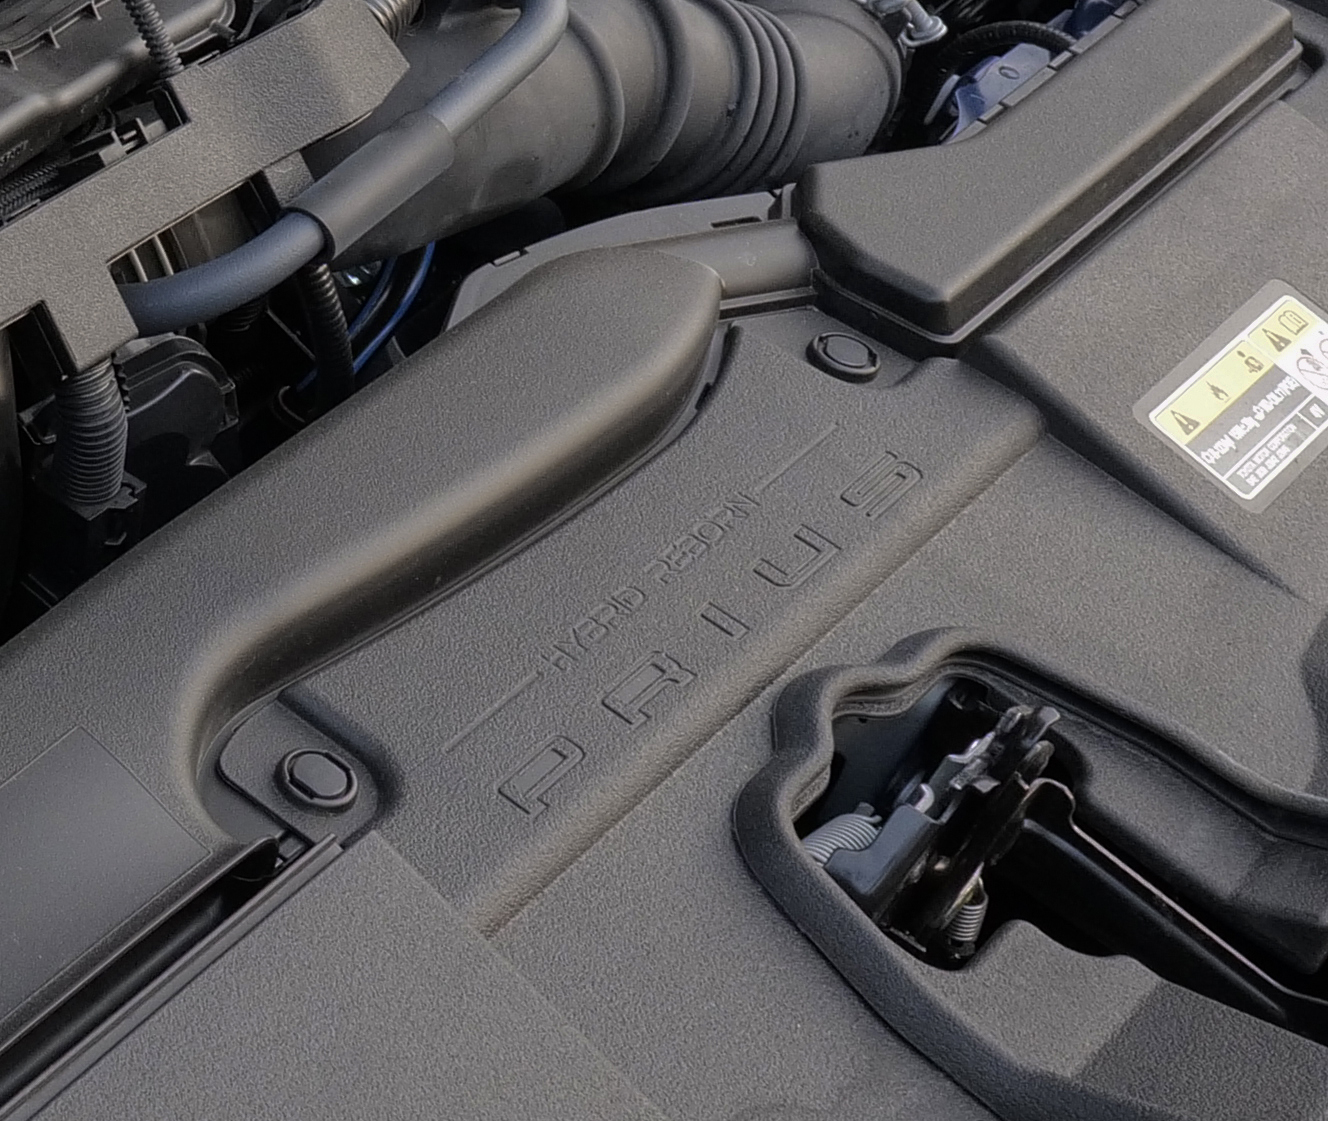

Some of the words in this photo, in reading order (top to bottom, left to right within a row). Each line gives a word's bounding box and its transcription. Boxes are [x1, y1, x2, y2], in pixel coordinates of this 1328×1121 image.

[497, 451, 924, 817] PRIUS
[543, 585, 645, 672] HYBRID
[656, 492, 761, 585] REBORN
